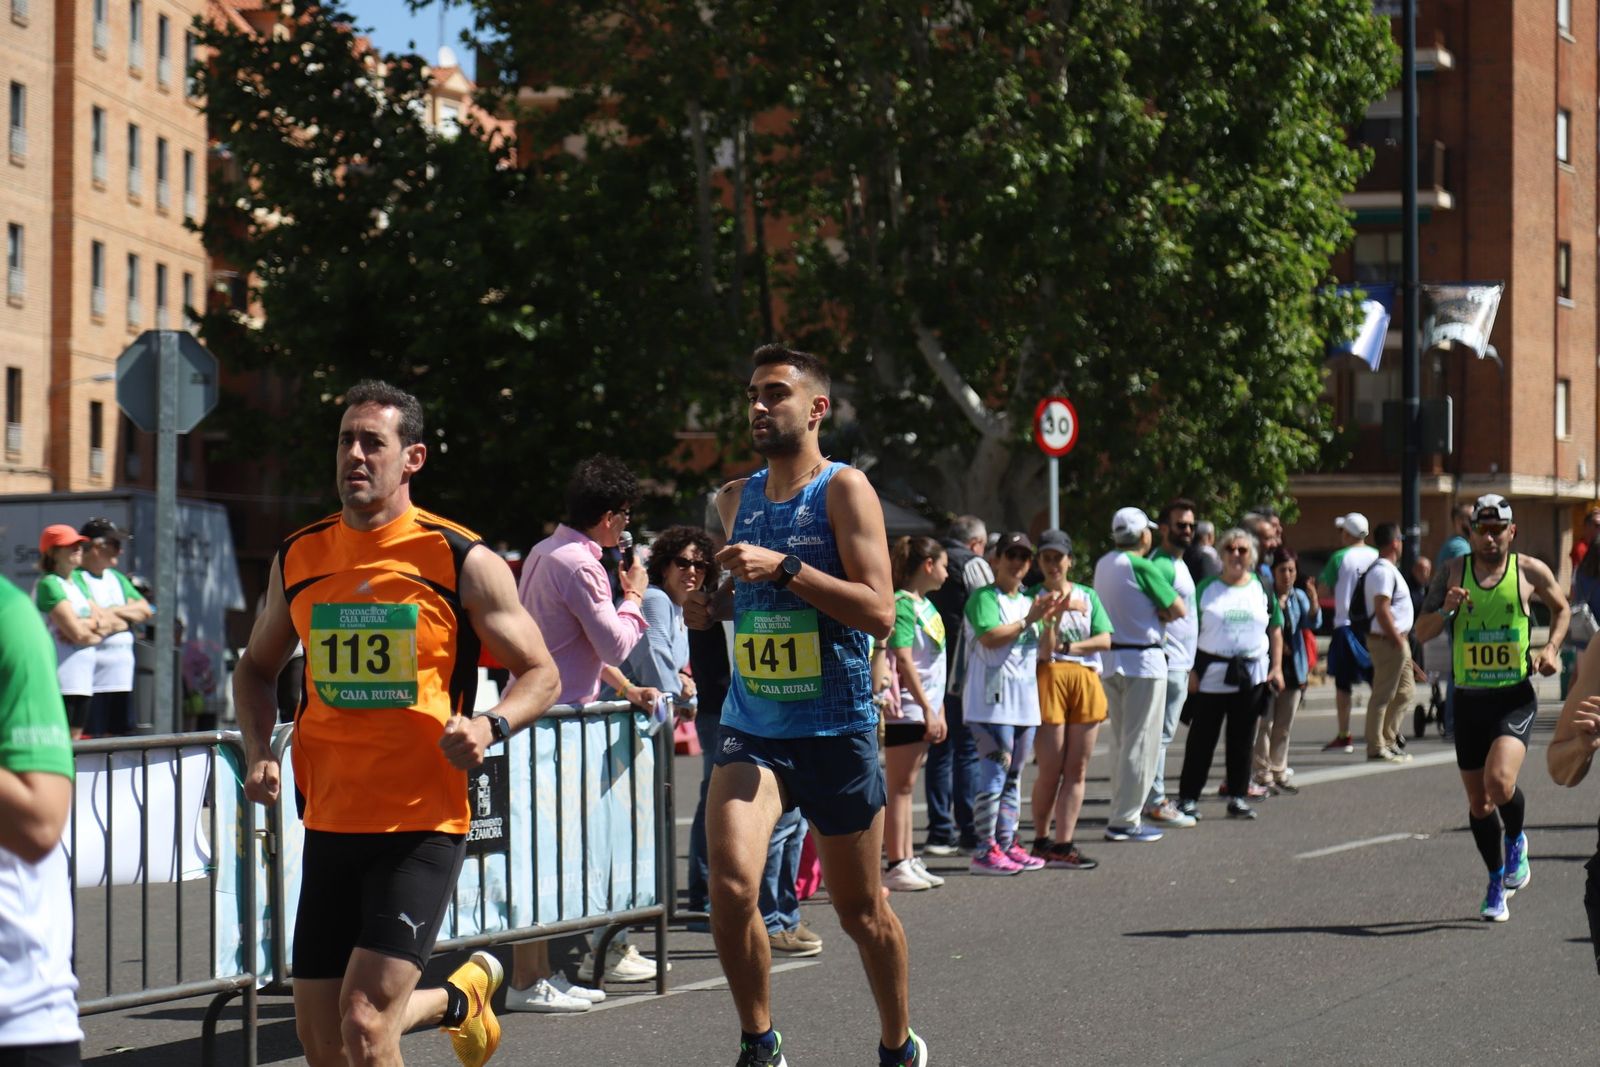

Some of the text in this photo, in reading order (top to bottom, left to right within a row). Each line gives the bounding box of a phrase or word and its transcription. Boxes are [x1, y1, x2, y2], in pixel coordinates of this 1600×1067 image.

[1045, 416, 1070, 435] 30
[340, 615, 388, 623] CAJA RURAL
[321, 634, 391, 675] 113
[743, 637, 797, 672] 141
[1468, 645, 1510, 666] 106
[340, 689, 413, 701] CAJA RURAL
[761, 683, 817, 694] CAJA RURAL
[475, 826, 503, 840] ZAMORA
